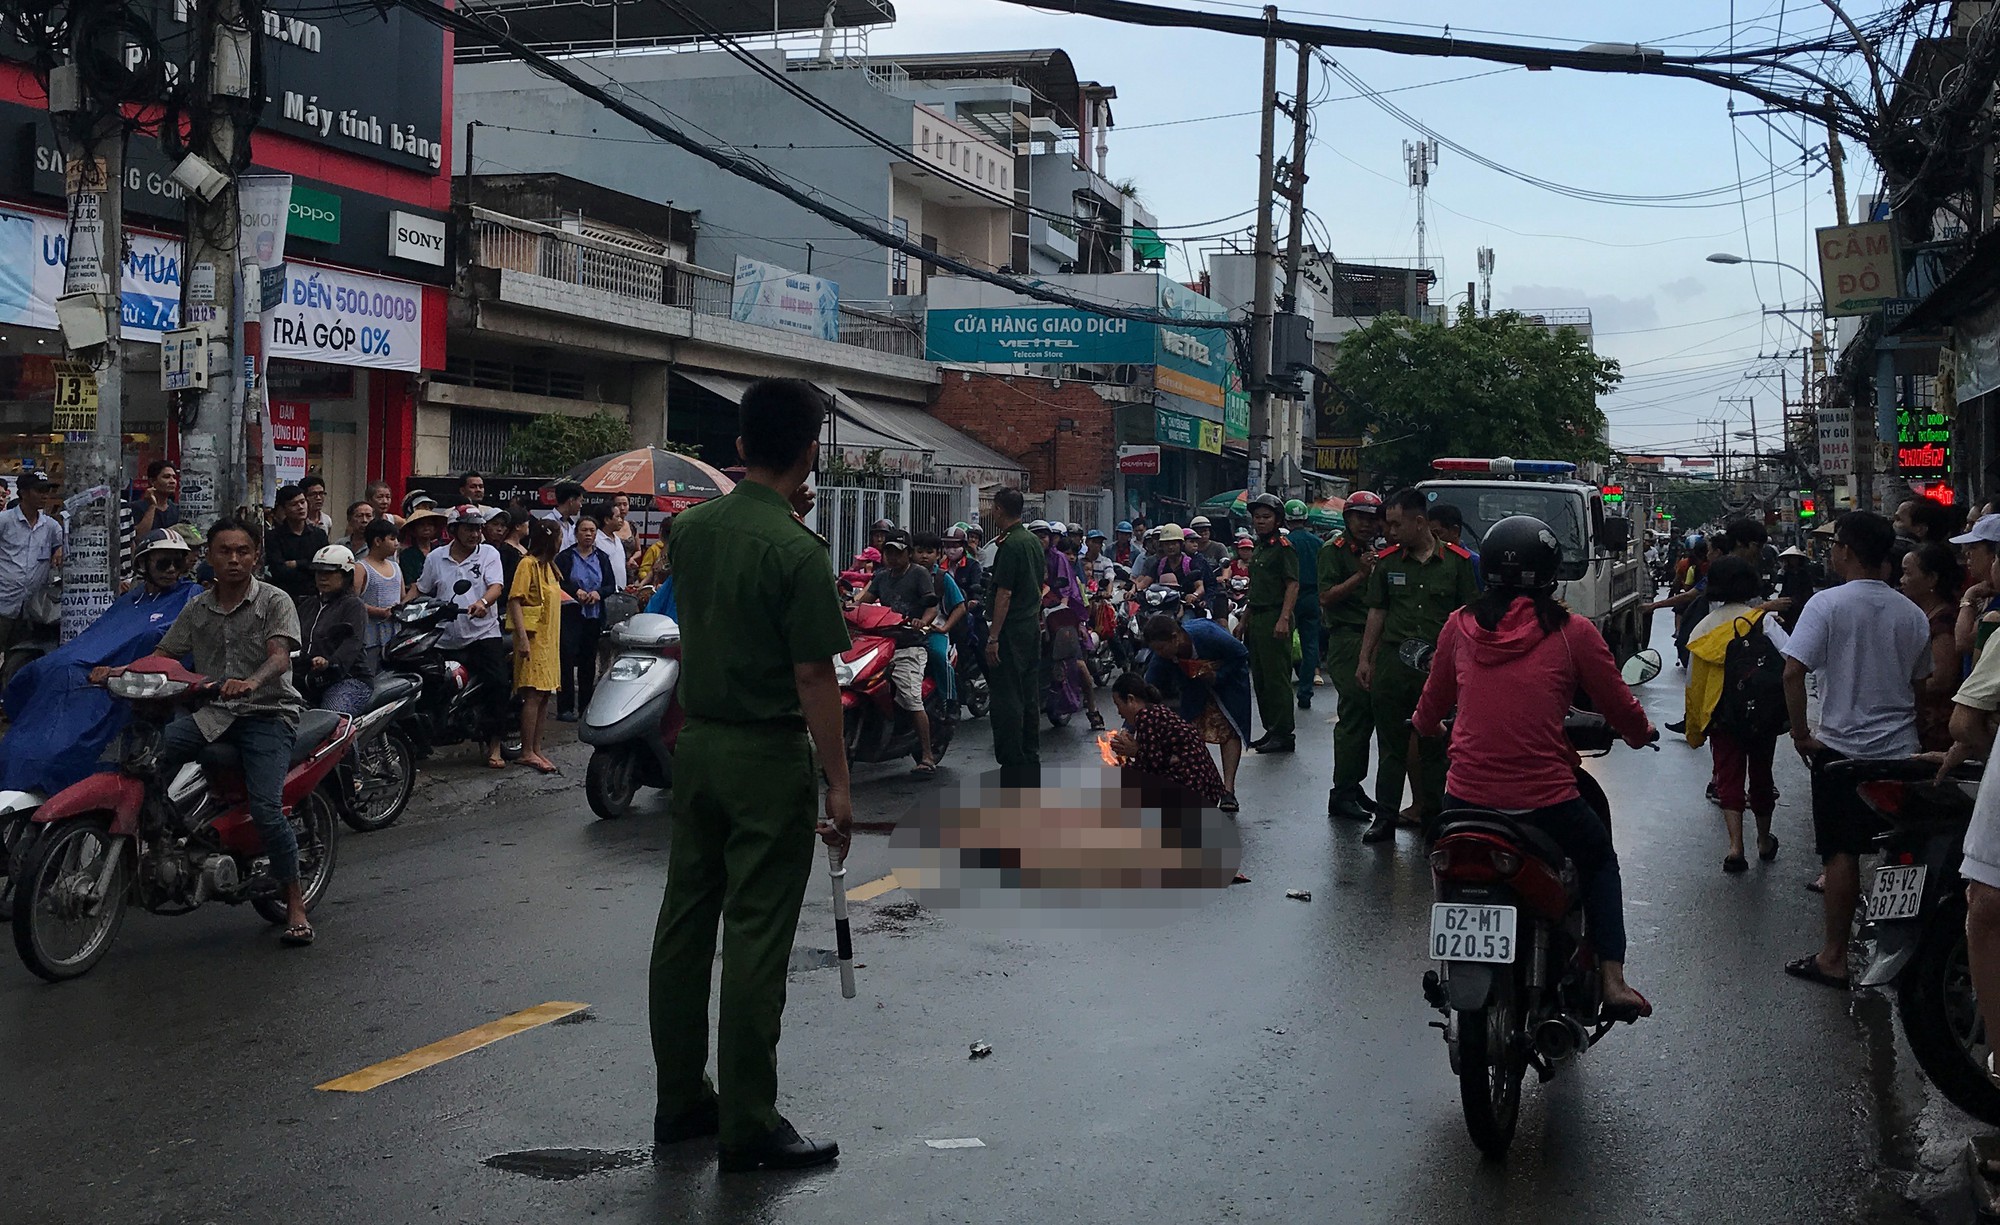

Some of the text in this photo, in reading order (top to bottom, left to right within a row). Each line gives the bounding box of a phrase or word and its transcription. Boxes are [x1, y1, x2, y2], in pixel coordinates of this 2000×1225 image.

[283, 91, 442, 169] Máy tính bảng
[397, 227, 443, 251] SONY
[1822, 229, 1889, 261] CẦM
[130, 246, 180, 287] MÙA
[1837, 262, 1881, 295] ĐỒ
[292, 271, 417, 322] ĐẾN 500.000Đ
[152, 300, 181, 330] 7.4
[954, 313, 1127, 337] CỬA HÀNG GIAO DỊCH
[273, 312, 391, 357] TRẢ GÓP 0%
[1013, 350, 1064, 358] Telecom Store
[271, 421, 306, 444] ƯỜNG LỰC
[628, 493, 648, 510] RIỆU
[1879, 868, 1918, 893] 59-V2
[1869, 892, 1917, 917] 387.20
[1445, 908, 1501, 932] 62-M1
[1435, 933, 1511, 959] 020.53
